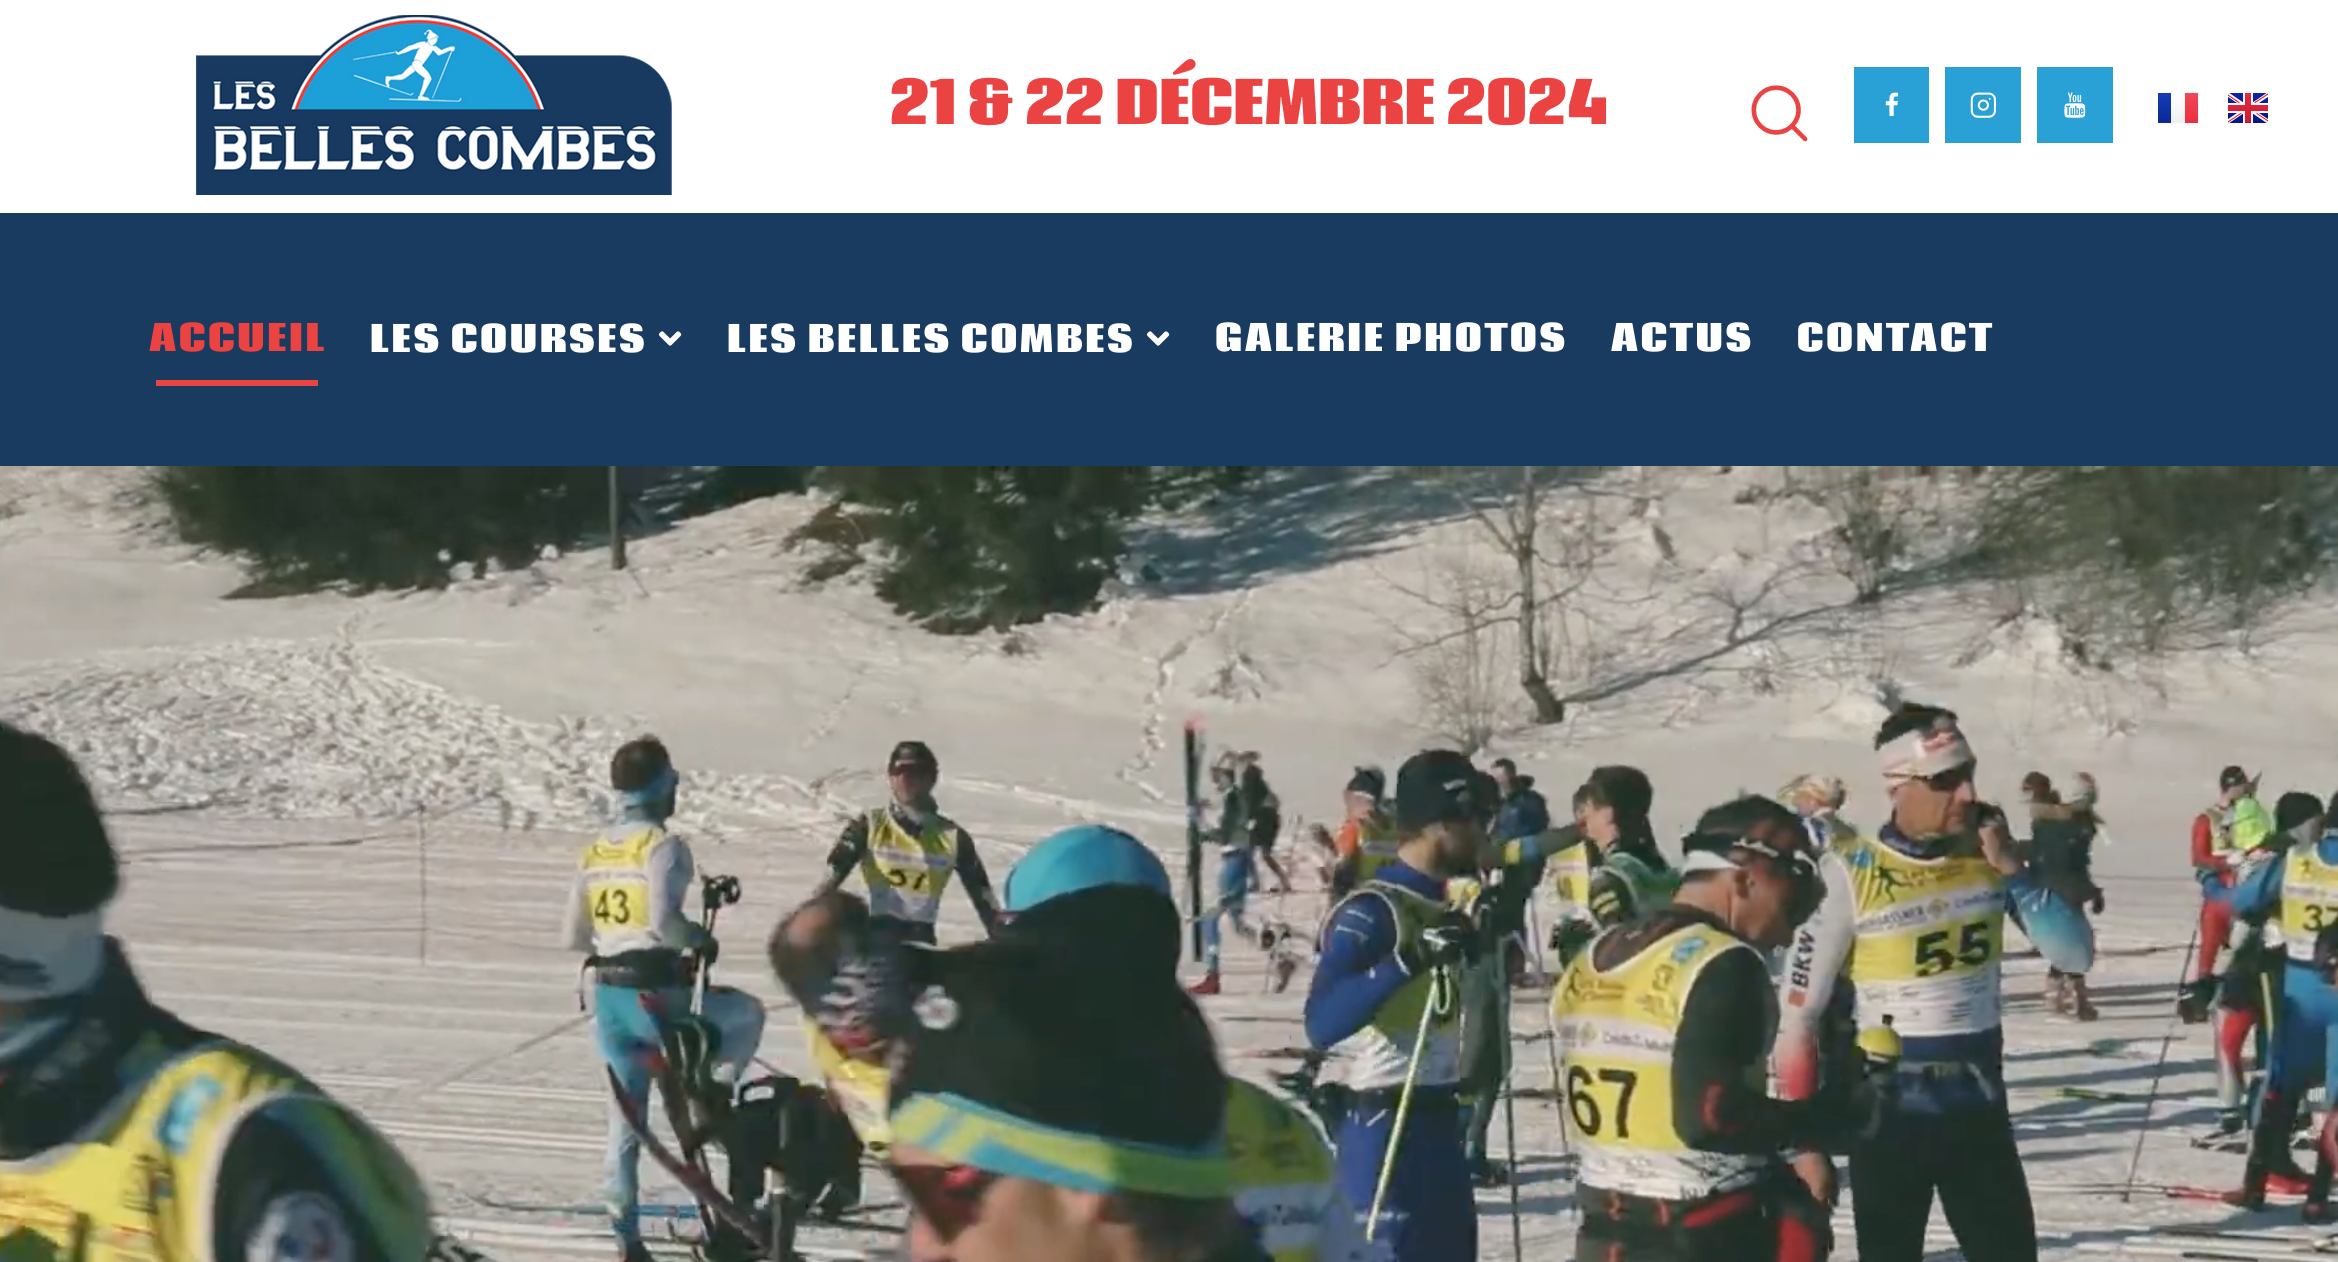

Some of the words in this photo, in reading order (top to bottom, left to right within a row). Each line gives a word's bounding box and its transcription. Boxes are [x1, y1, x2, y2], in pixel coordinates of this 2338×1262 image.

[213, 81, 275, 110] LES
[891, 78, 954, 124] 21
[969, 78, 1013, 125] &
[1027, 78, 1103, 124] 22
[1117, 59, 1434, 125] DÉCEMBRE
[1448, 78, 1606, 125] 2024
[2067, 92, 2082, 102] You
[2065, 105, 2085, 116] Tube
[214, 126, 414, 170] BELLES
[438, 126, 656, 170] COMBES
[150, 322, 324, 352] ACCUEIL
[371, 323, 439, 353] LES
[452, 323, 644, 353] COURSES
[728, 323, 795, 353] LES
[809, 323, 949, 353] BELLES
[962, 323, 1132, 353] COMBES
[1216, 322, 1382, 352] GALERIE
[1396, 322, 1565, 352] PHOTOS
[1611, 322, 1751, 352] ACTUS
[1798, 322, 1992, 352] CONTACT
[594, 888, 631, 924] 43
[1790, 929, 1816, 989] BKW
[1914, 922, 1990, 978] 55
[1568, 1064, 1638, 1139] 67
